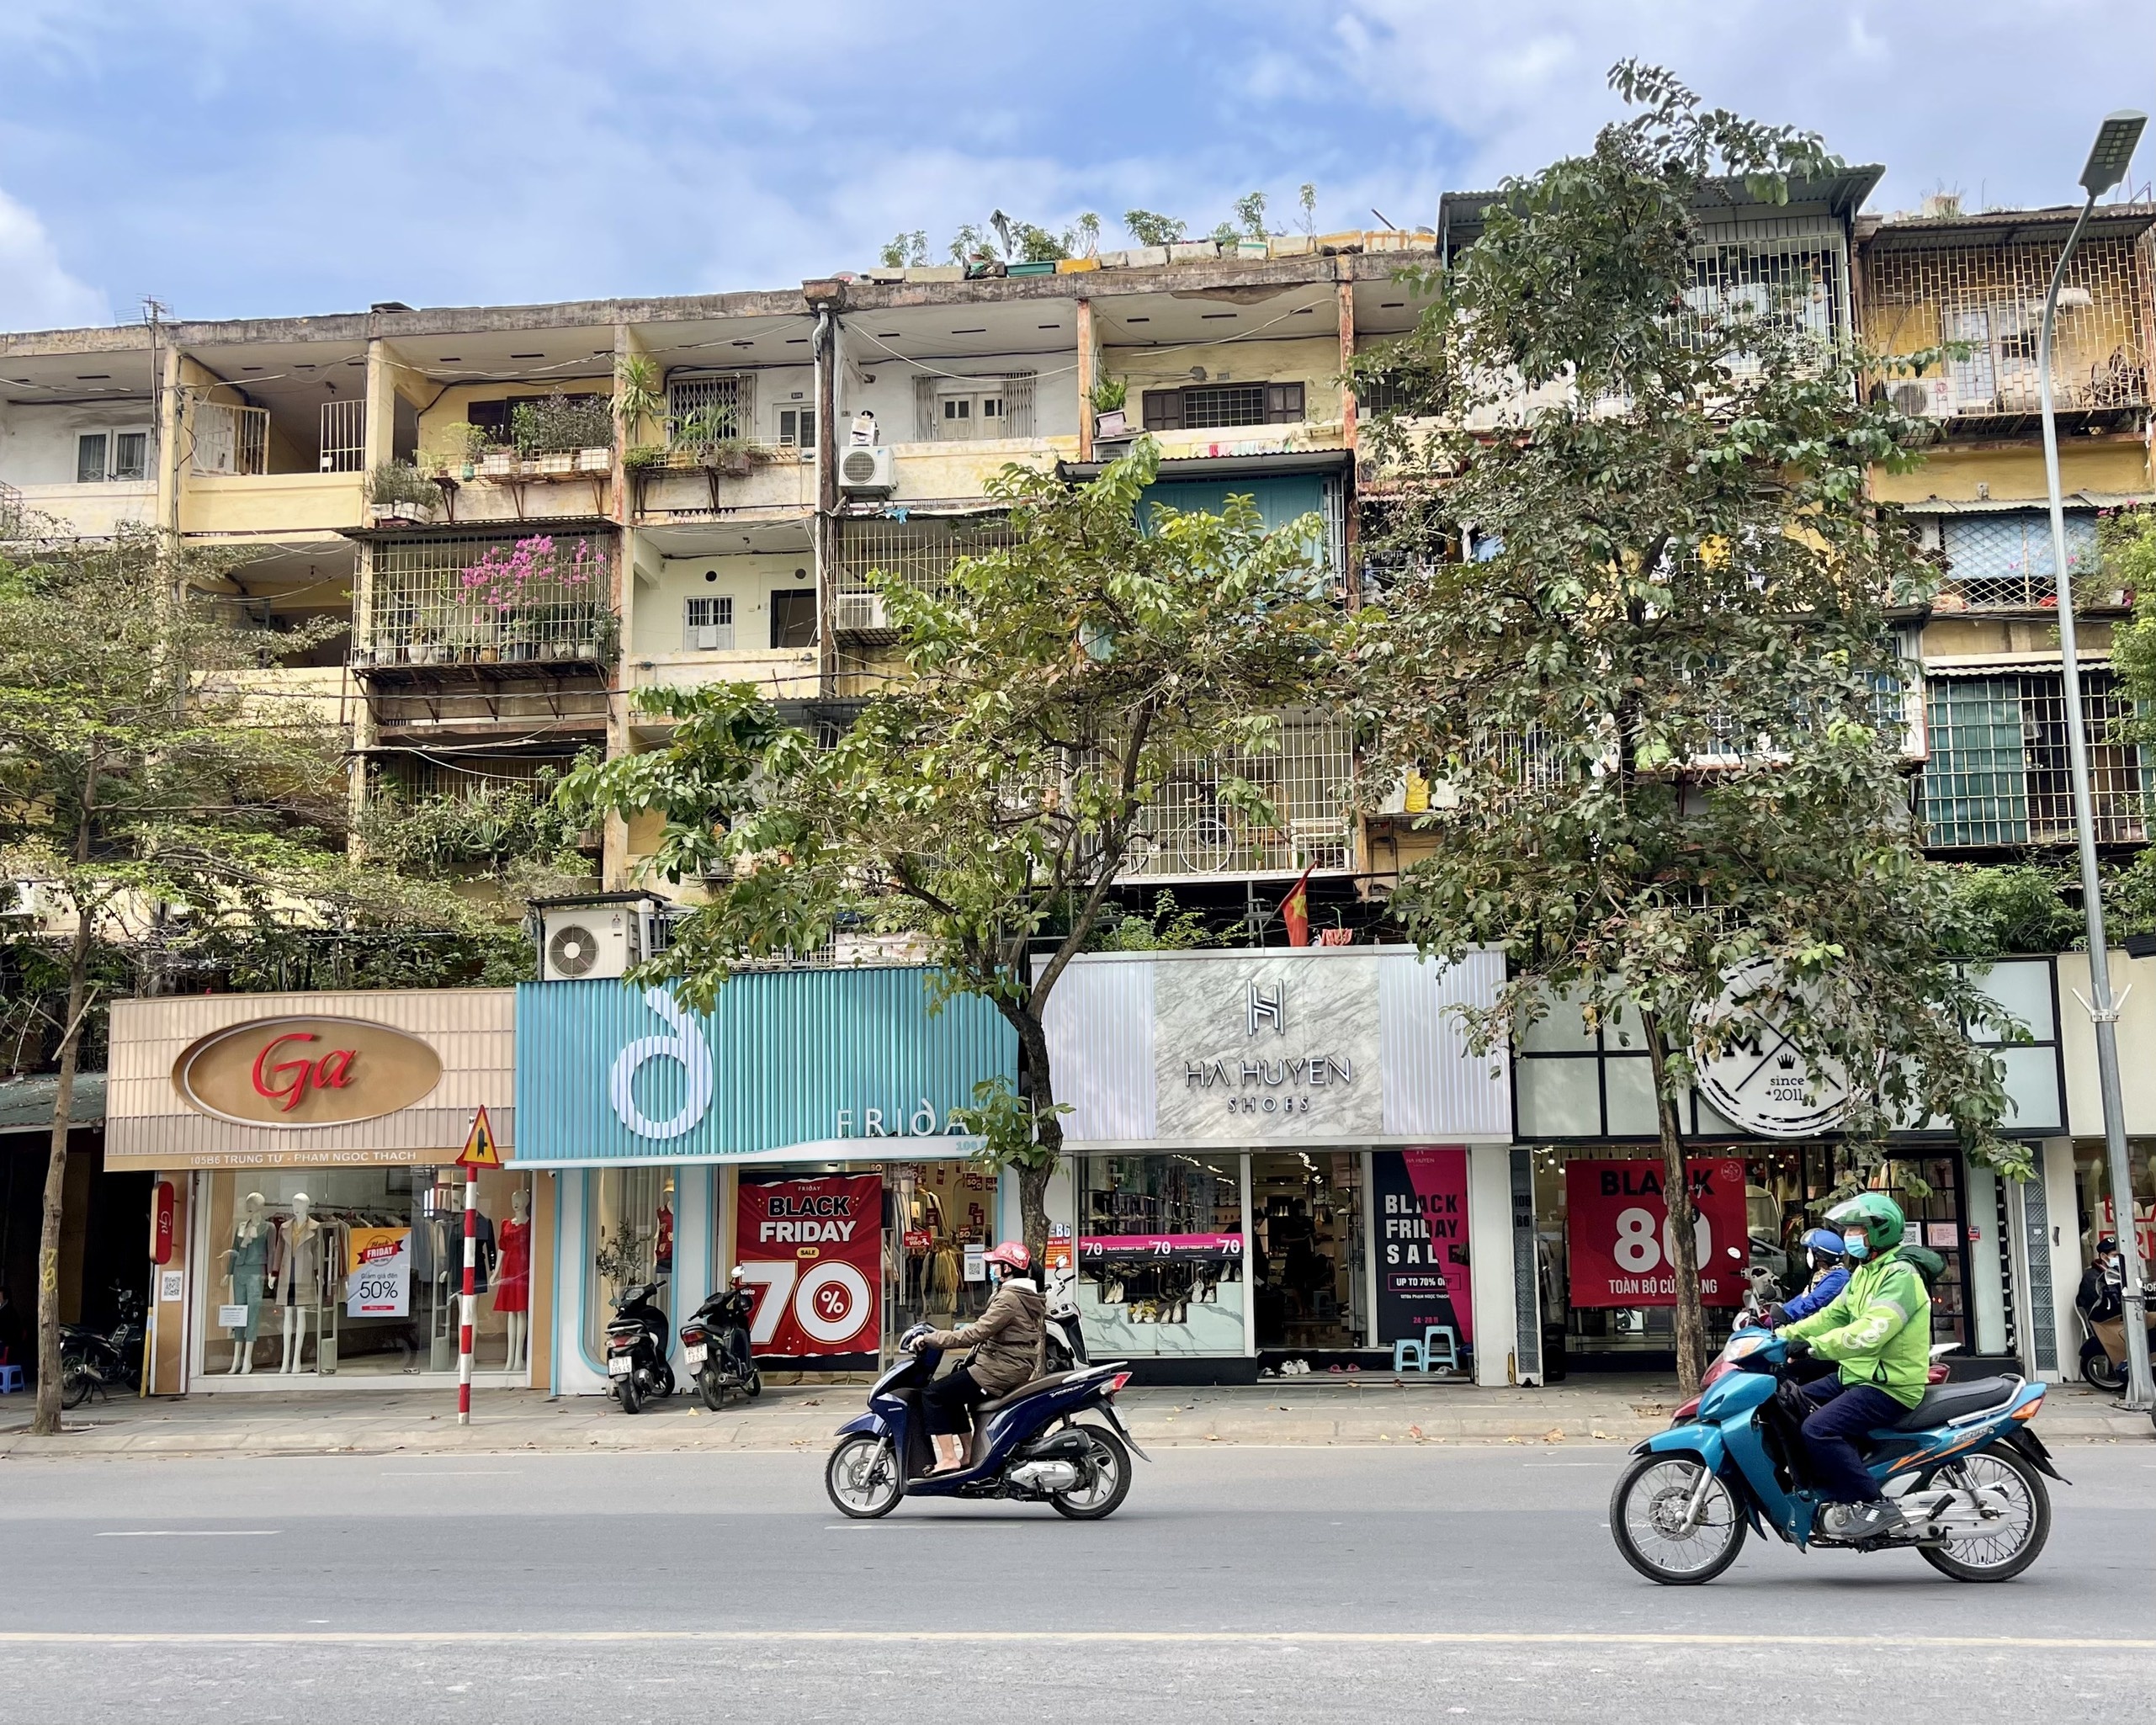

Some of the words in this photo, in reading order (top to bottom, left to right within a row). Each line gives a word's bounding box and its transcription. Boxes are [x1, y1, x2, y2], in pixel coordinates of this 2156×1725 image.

[252, 1032, 357, 1113] Ga
[1185, 1059, 1230, 1087] HA
[1240, 1056, 1351, 1086] HUYEN
[1770, 1075, 1805, 1086] since
[1228, 1096, 1309, 1112] SHOES
[1773, 1089, 1803, 1101] 2011
[837, 1097, 993, 1137] FRIDA
[189, 1156, 220, 1165] 105B6
[224, 1154, 263, 1165] TRUNG
[333, 1152, 369, 1164] NGỌC
[1601, 1169, 1715, 1196] BLAK
[767, 1196, 851, 1217] BLACK
[1384, 1194, 1458, 1213] BLACK
[760, 1220, 857, 1243] FRIDAY
[1385, 1219, 1458, 1239] FRIDAY
[1085, 1243, 1102, 1255] 70
[1153, 1241, 1171, 1255] 70
[1220, 1239, 1240, 1254] 70
[1613, 1207, 1712, 1273] 80
[367, 1245, 394, 1259] FRIDAY
[1386, 1244, 1460, 1264] SALE
[359, 1281, 398, 1299] 50%
[1396, 1277, 1407, 1287] UP
[1409, 1277, 1418, 1287] TO
[1420, 1277, 1436, 1287] 70%
[1608, 1276, 1639, 1294] TOÀN
[1642, 1276, 1657, 1297] BỘ
[1659, 1274, 1678, 1294] CỬ
[1842, 1319, 1889, 1350] Grab
